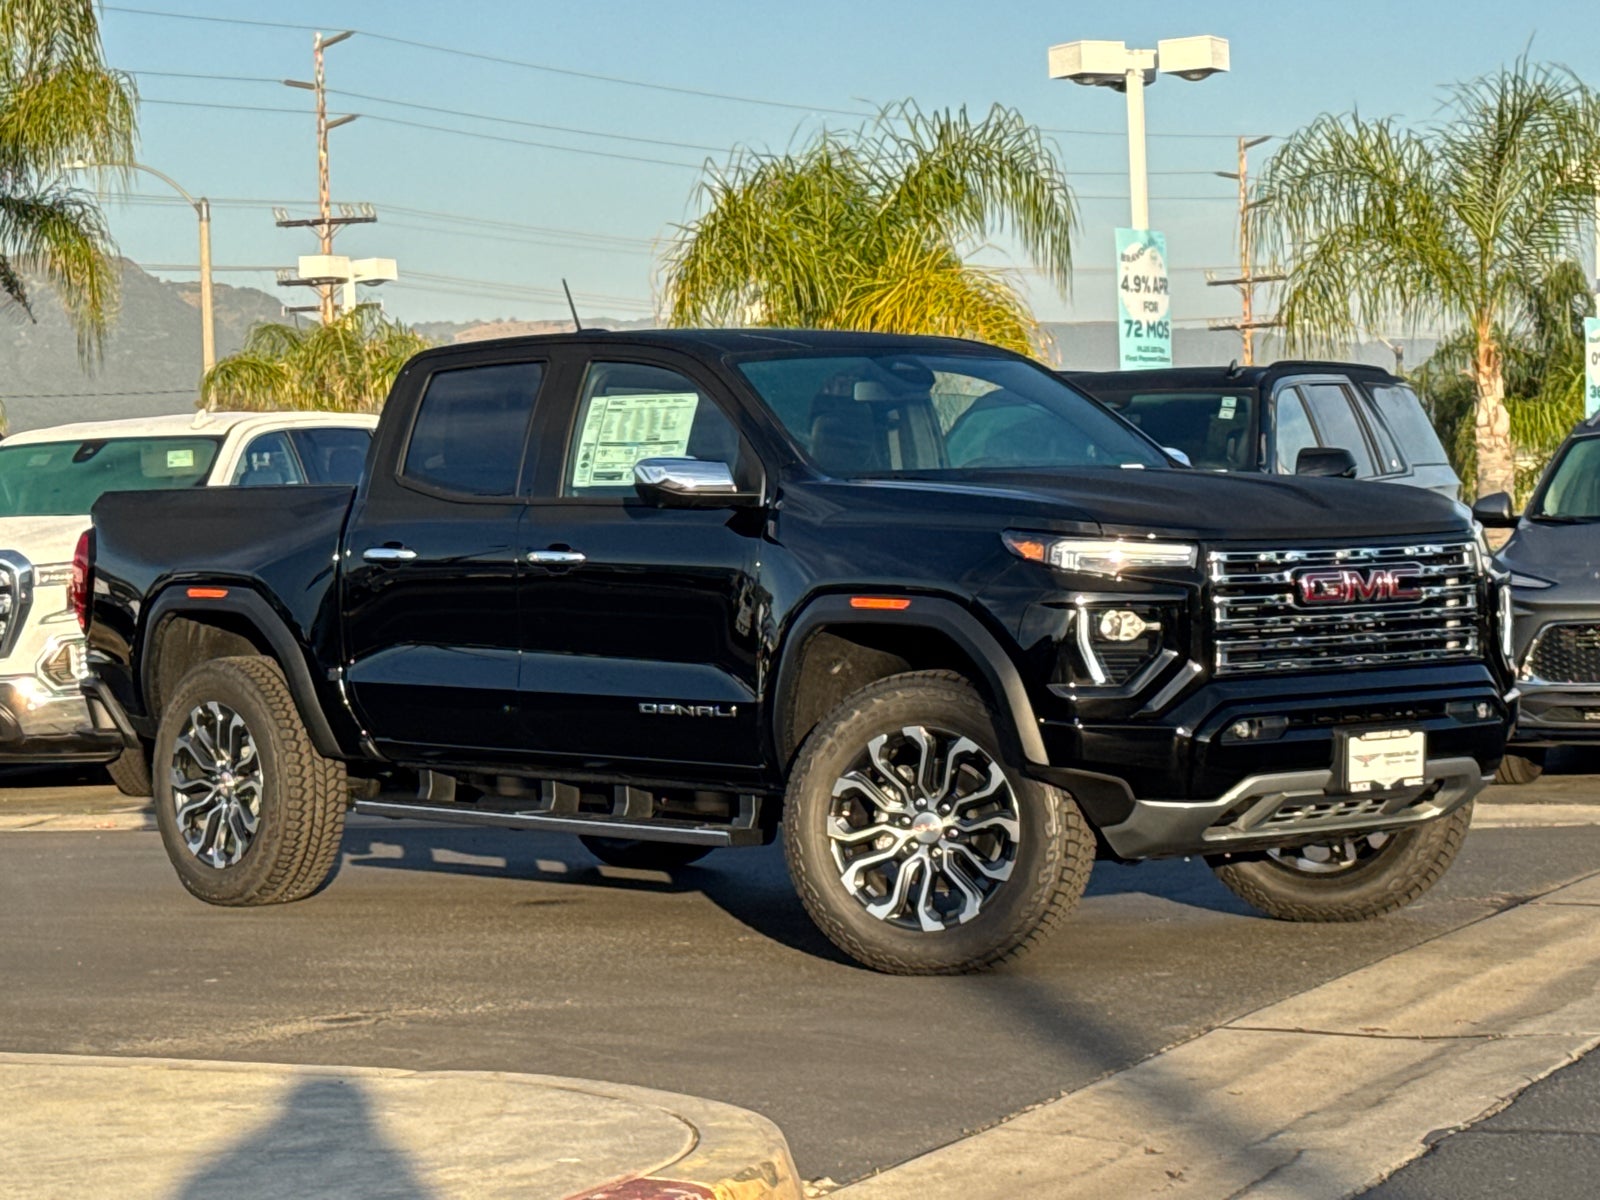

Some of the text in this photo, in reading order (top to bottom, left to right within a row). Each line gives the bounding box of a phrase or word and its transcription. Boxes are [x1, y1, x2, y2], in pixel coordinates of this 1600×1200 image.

[1121, 274, 1169, 296] 4.9% APR
[1143, 301, 1159, 313] FOR
[1124, 319, 1170, 340] 72 MOS
[1300, 568, 1422, 604] GMC
[638, 703, 737, 718] DENALI
